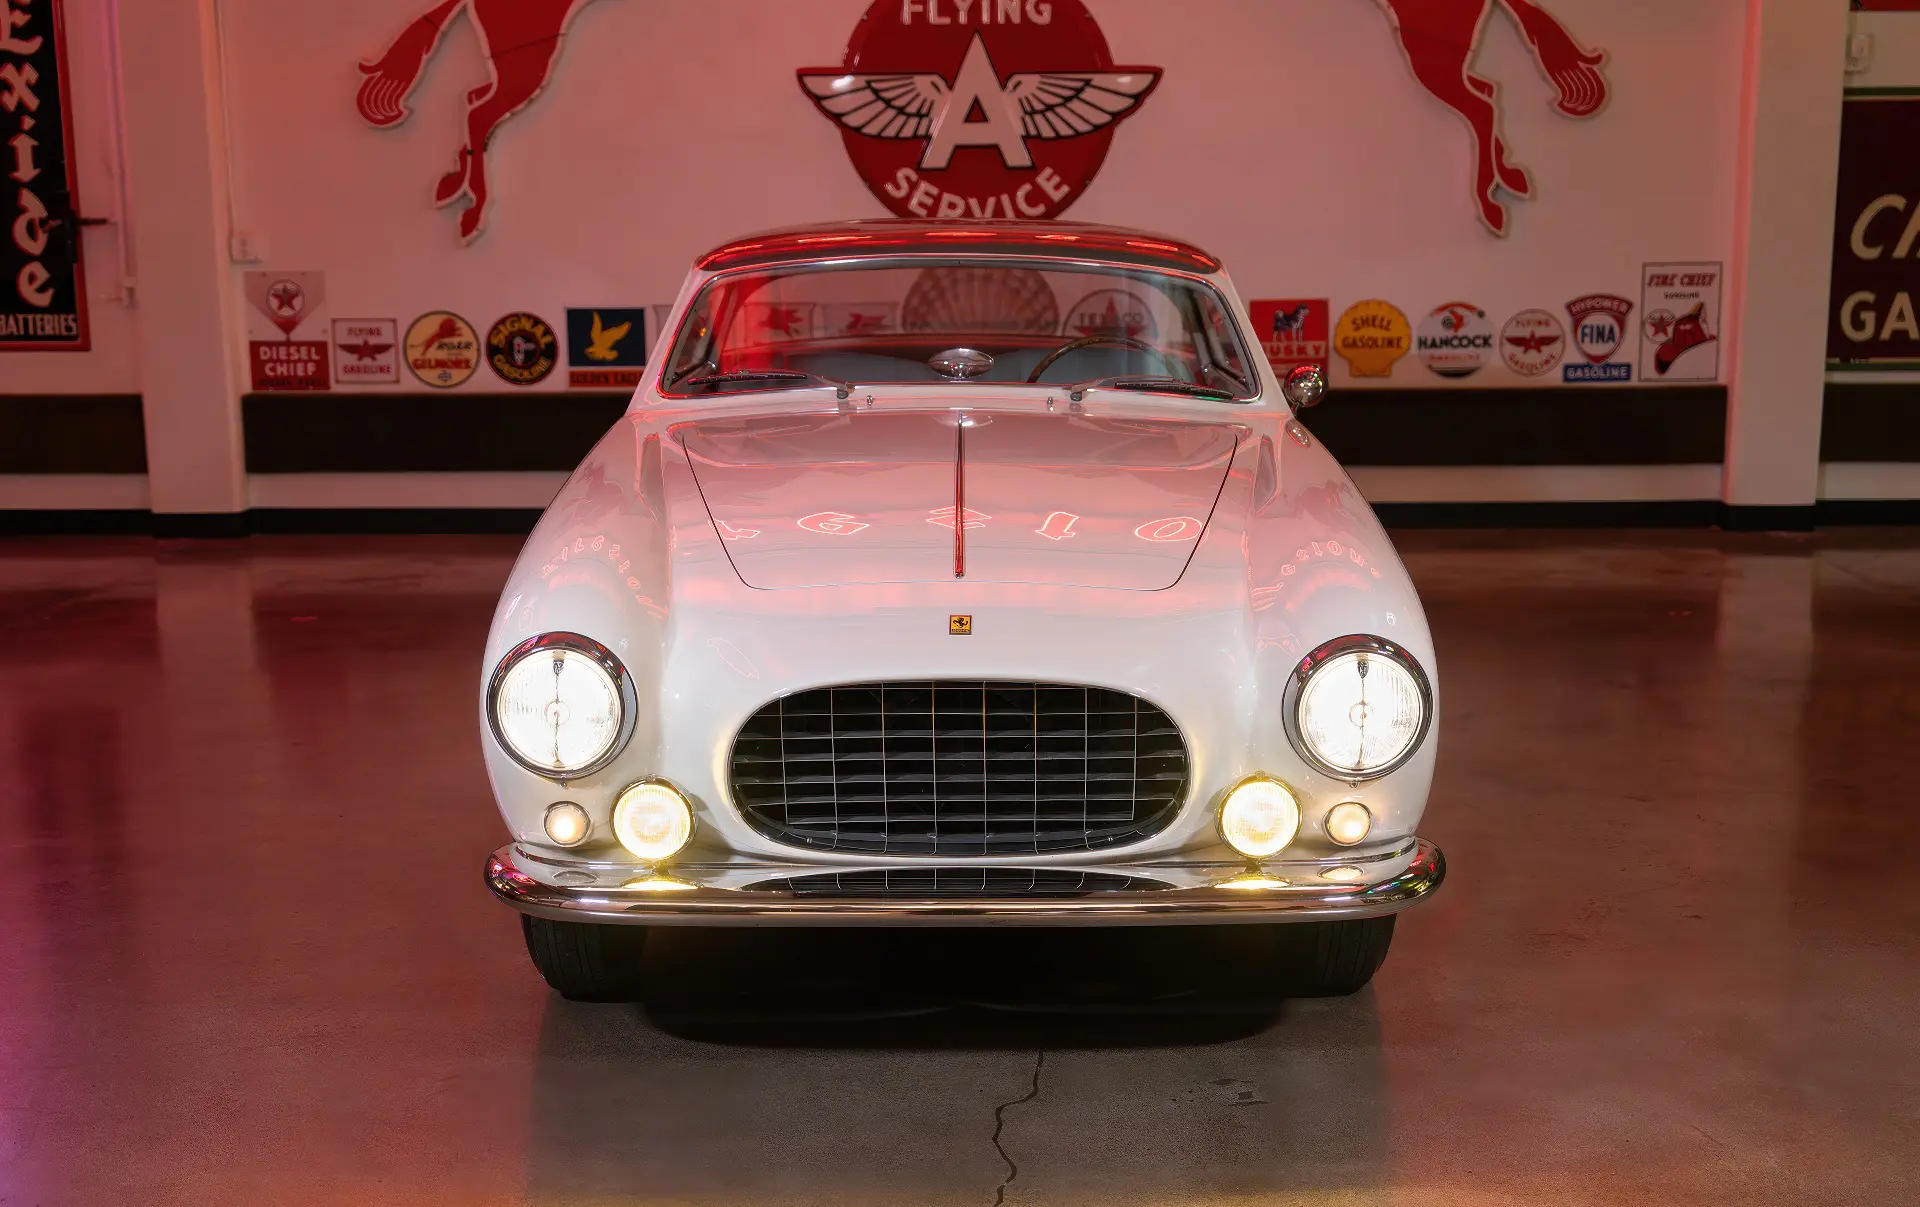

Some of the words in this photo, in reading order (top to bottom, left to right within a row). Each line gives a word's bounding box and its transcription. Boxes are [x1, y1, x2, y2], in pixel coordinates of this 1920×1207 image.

[903, 0, 1053, 25] FLYING
[884, 166, 1072, 219] SERVICE
[1680, 273, 1716, 287] CHIEF
[0, 314, 77, 336] BATTERIES
[1352, 314, 1393, 332] SHELL
[490, 316, 553, 349] SIGNAL
[1580, 323, 1617, 345] FINA
[1341, 335, 1403, 349] GASOLINE
[1418, 334, 1493, 350] HANCOCK
[259, 346, 321, 361] DIESEL
[1264, 344, 1322, 357] USKY
[264, 362, 317, 377] CHIEF
[1566, 366, 1628, 378] GASOLINE
